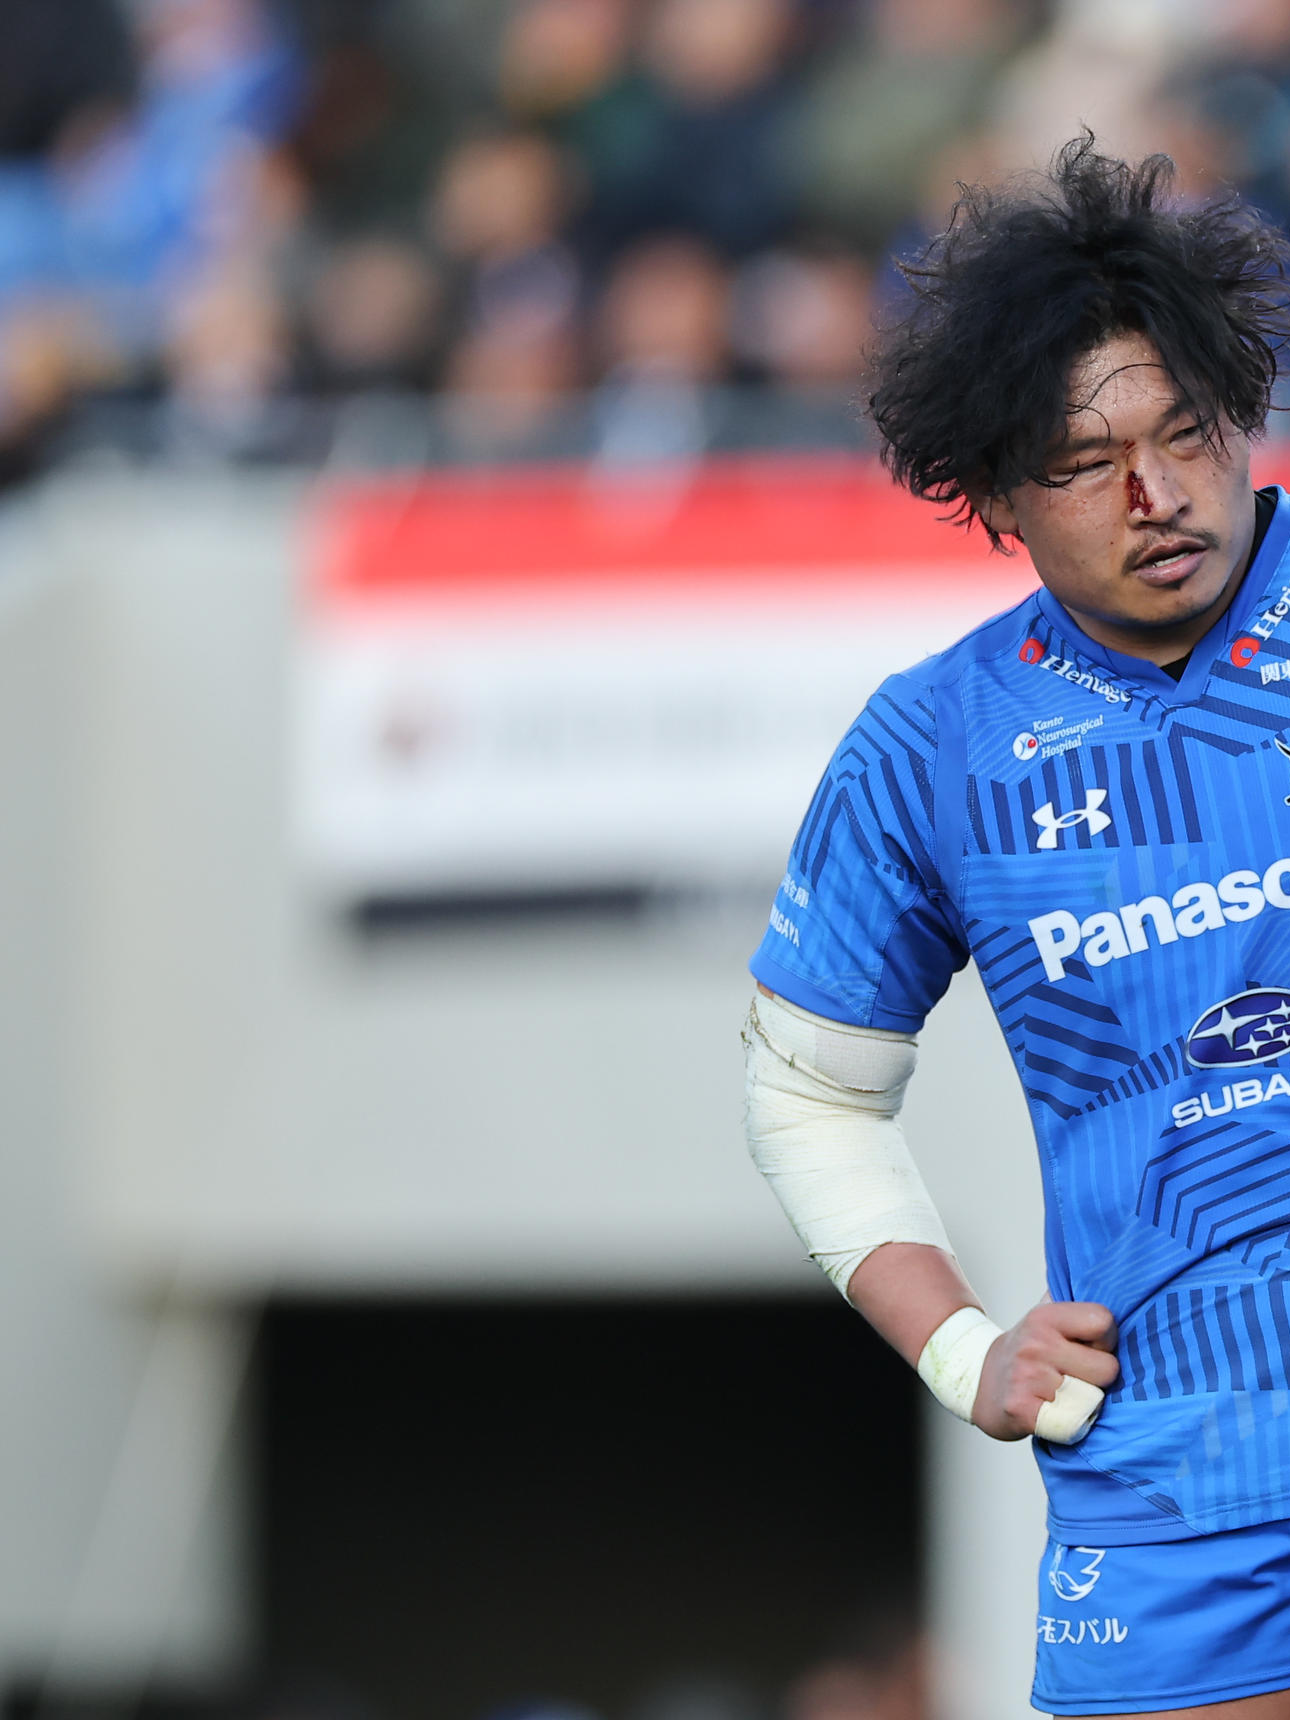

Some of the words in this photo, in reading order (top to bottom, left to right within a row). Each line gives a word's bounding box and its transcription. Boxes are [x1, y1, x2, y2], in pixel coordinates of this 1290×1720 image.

[1032, 715, 1064, 733] Kanto
[1036, 714, 1105, 746] Neurosurgical
[1041, 734, 1083, 760] Hospital
[1038, 1615, 1129, 1645] 玉スバル
